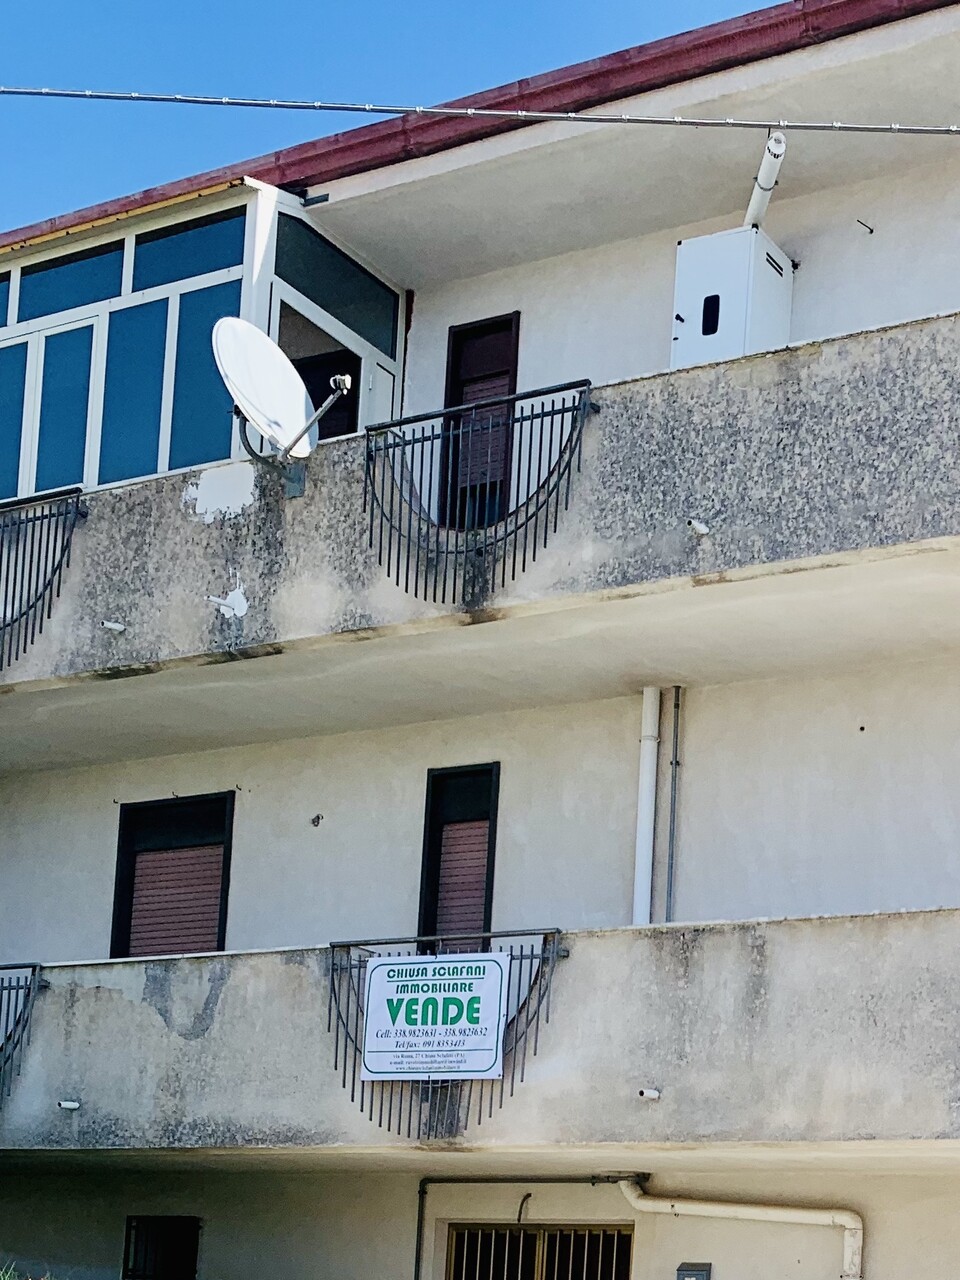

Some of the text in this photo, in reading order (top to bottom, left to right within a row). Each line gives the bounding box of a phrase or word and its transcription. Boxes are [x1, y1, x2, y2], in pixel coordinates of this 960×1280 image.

[387, 965, 486, 979] CHIUSA SCLAFANI
[396, 982, 474, 994] IMMOBILIARE
[386, 996, 481, 1027] VENDE
[376, 1029, 392, 1039] Cell:
[393, 1028, 437, 1039] 338.9823631
[443, 1027, 488, 1038] 338.9823632
[422, 1040, 435, 1048] 091
[436, 1039, 465, 1048] 8353413
